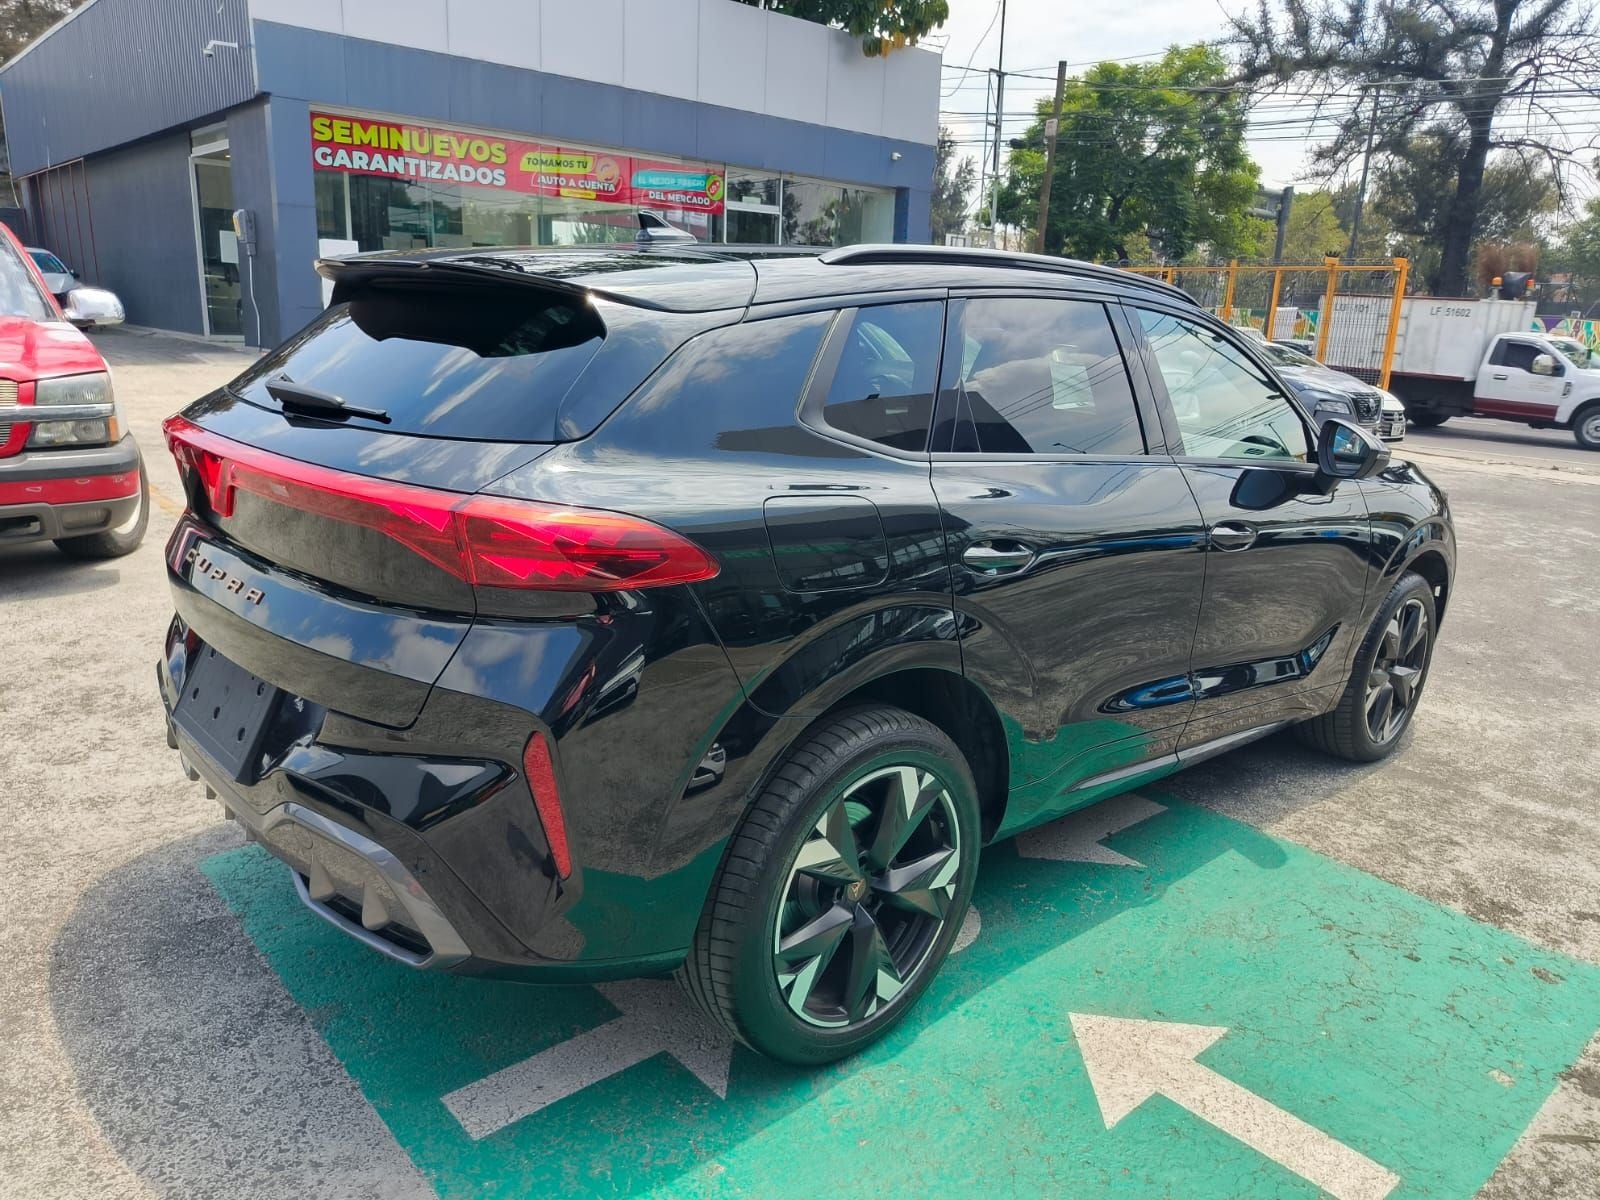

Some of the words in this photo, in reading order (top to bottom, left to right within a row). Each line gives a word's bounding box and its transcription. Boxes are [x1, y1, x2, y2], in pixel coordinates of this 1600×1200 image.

[312, 117, 507, 164] SEMINUEVOS
[314, 146, 506, 186] GARANTIZADOS
[526, 157, 574, 169] TOMAMOS
[576, 161, 588, 169] TU
[537, 175, 566, 186] AUTO
[568, 179, 576, 187] A
[578, 180, 616, 192] CUENTA
[648, 190, 666, 201] DEL
[667, 194, 710, 205] MERCADO
[1430, 306, 1442, 316] LF
[1445, 307, 1472, 318] 51602
[185, 548, 266, 605] CUPRA
